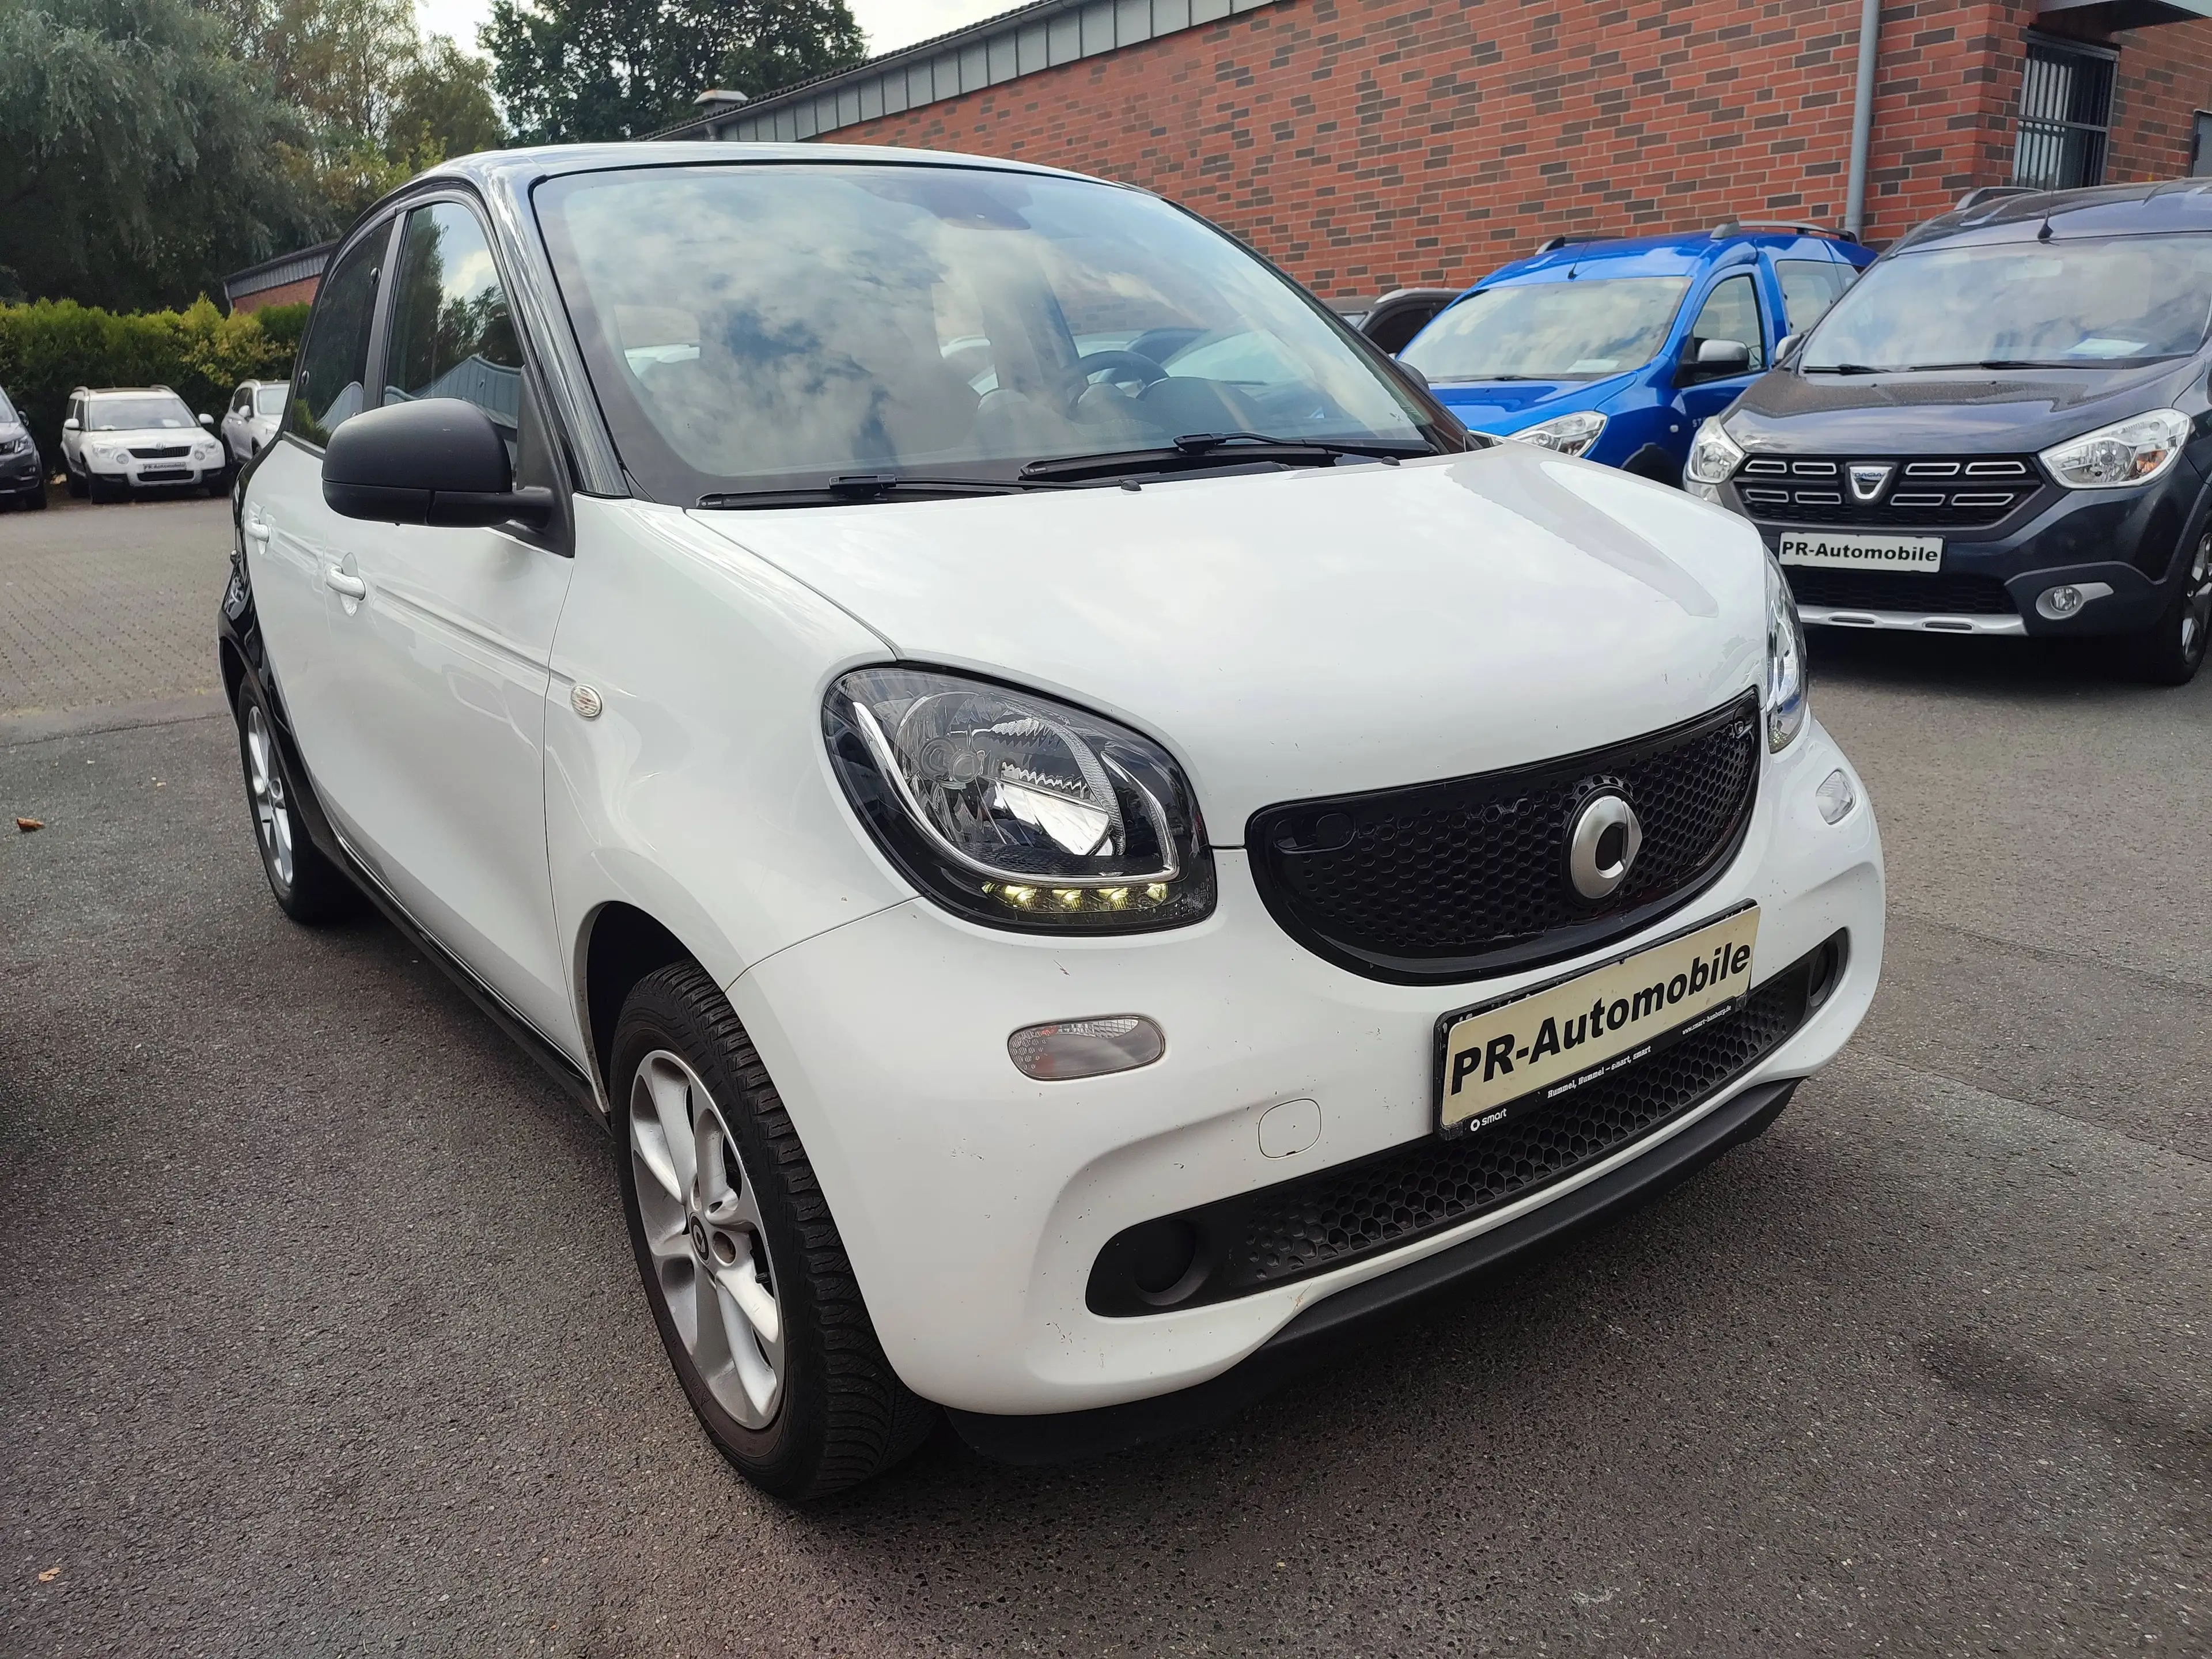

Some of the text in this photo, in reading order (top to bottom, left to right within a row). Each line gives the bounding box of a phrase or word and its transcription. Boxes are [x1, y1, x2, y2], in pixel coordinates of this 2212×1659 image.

[1782, 541, 1938, 562] PR-Automobile
[1451, 942, 1750, 1096] PR-Automobile
[1547, 1080, 1577, 1099] Hummel,
[1578, 1066, 1604, 1085] Hummel
[1611, 1055, 1632, 1071] smart,
[1633, 1046, 1651, 1060] smart
[1481, 1108, 1508, 1126] smart
